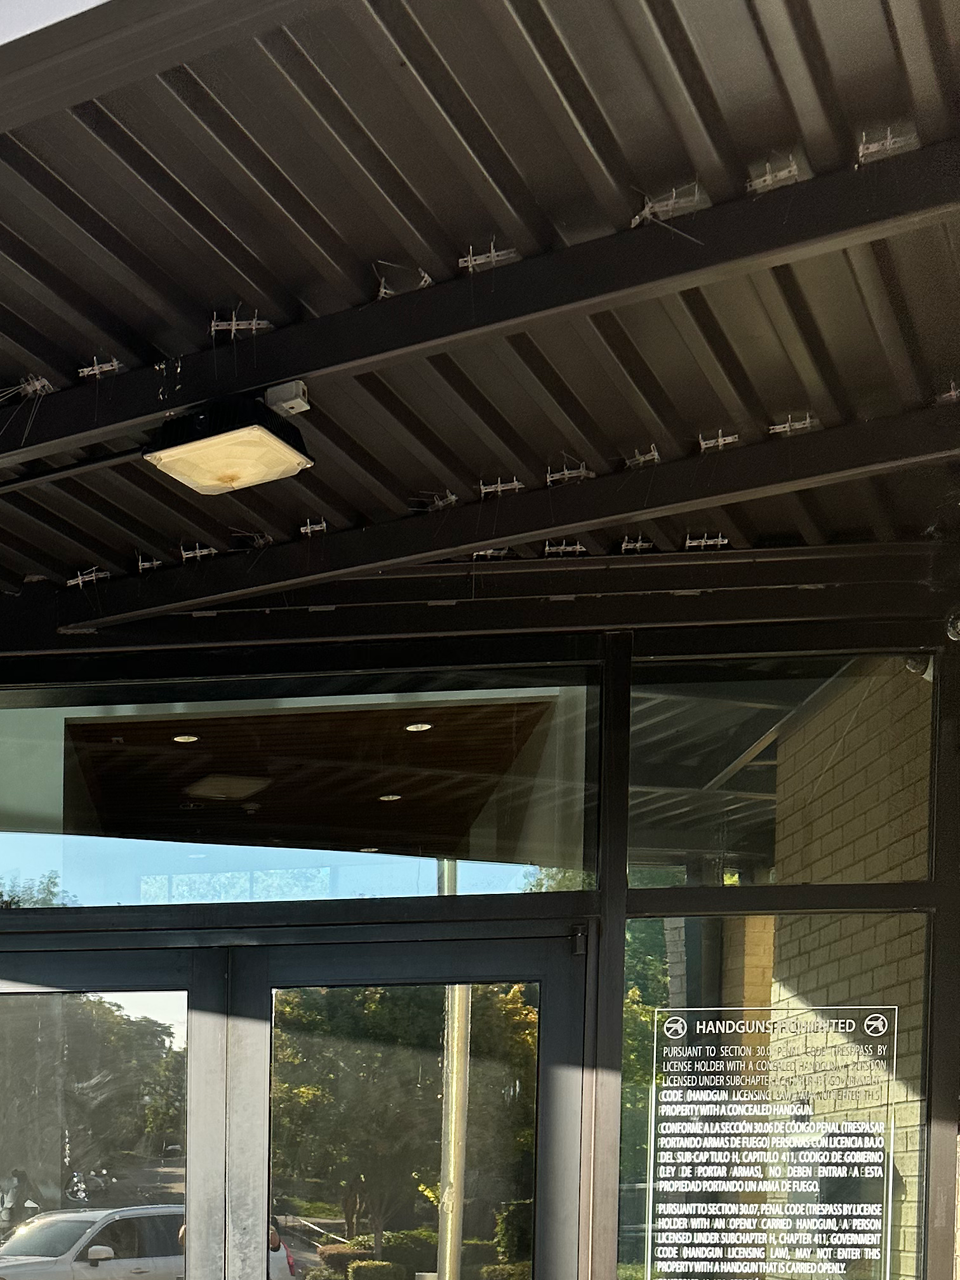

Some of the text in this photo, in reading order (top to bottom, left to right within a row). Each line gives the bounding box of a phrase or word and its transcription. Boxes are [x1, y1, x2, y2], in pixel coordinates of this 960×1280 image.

[696, 1021, 772, 1033] HANDGUNS
[664, 1045, 887, 1057] PURSUANT TO SECTION BY
[663, 1061, 745, 1071] LICENSE HOLDER WITH
[663, 1076, 724, 1086] LICENSED UNDER
[662, 1090, 683, 1101] CODE
[687, 1090, 728, 1101] (HANDGUN
[733, 1090, 770, 1101] LICENSING
[662, 1105, 814, 1116] PROPERTY WITH CONCEALED HANDGUN.
[661, 1122, 885, 1134] CONFORME 30.06 DE PENAL (TRESPASAR
[661, 1137, 884, 1148] PORTANDO ARMAS DE PERSONAS LICENCIA BAJO
[742, 1152, 883, 1162] CAPITULO CODIGO DE GOBIERNO
[682, 1166, 883, 1177] DE PORTAR NO DEBEN ENTRAR ESTA
[660, 1181, 820, 1191] PROPIEDAD PORTANDO UN ARMA DE FUEGO.
[660, 1204, 882, 1215] PURSUANT SECTION PENAL CODE (TRESPASS BY LICENSE
[660, 1218, 881, 1230] HOLDER WITH OPENLY CARRIED PERSON
[658, 1232, 881, 1244] LICENSED UNDER SUBCHAPTER CHAPTER GOVERNMENT
[658, 1247, 881, 1259] CODE (HANDGUN LICENSING MAY NOT ENTER THIS
[657, 1262, 846, 1273] PROPERTY WITH HANDGUN THAT CARRIED OPENLY.
